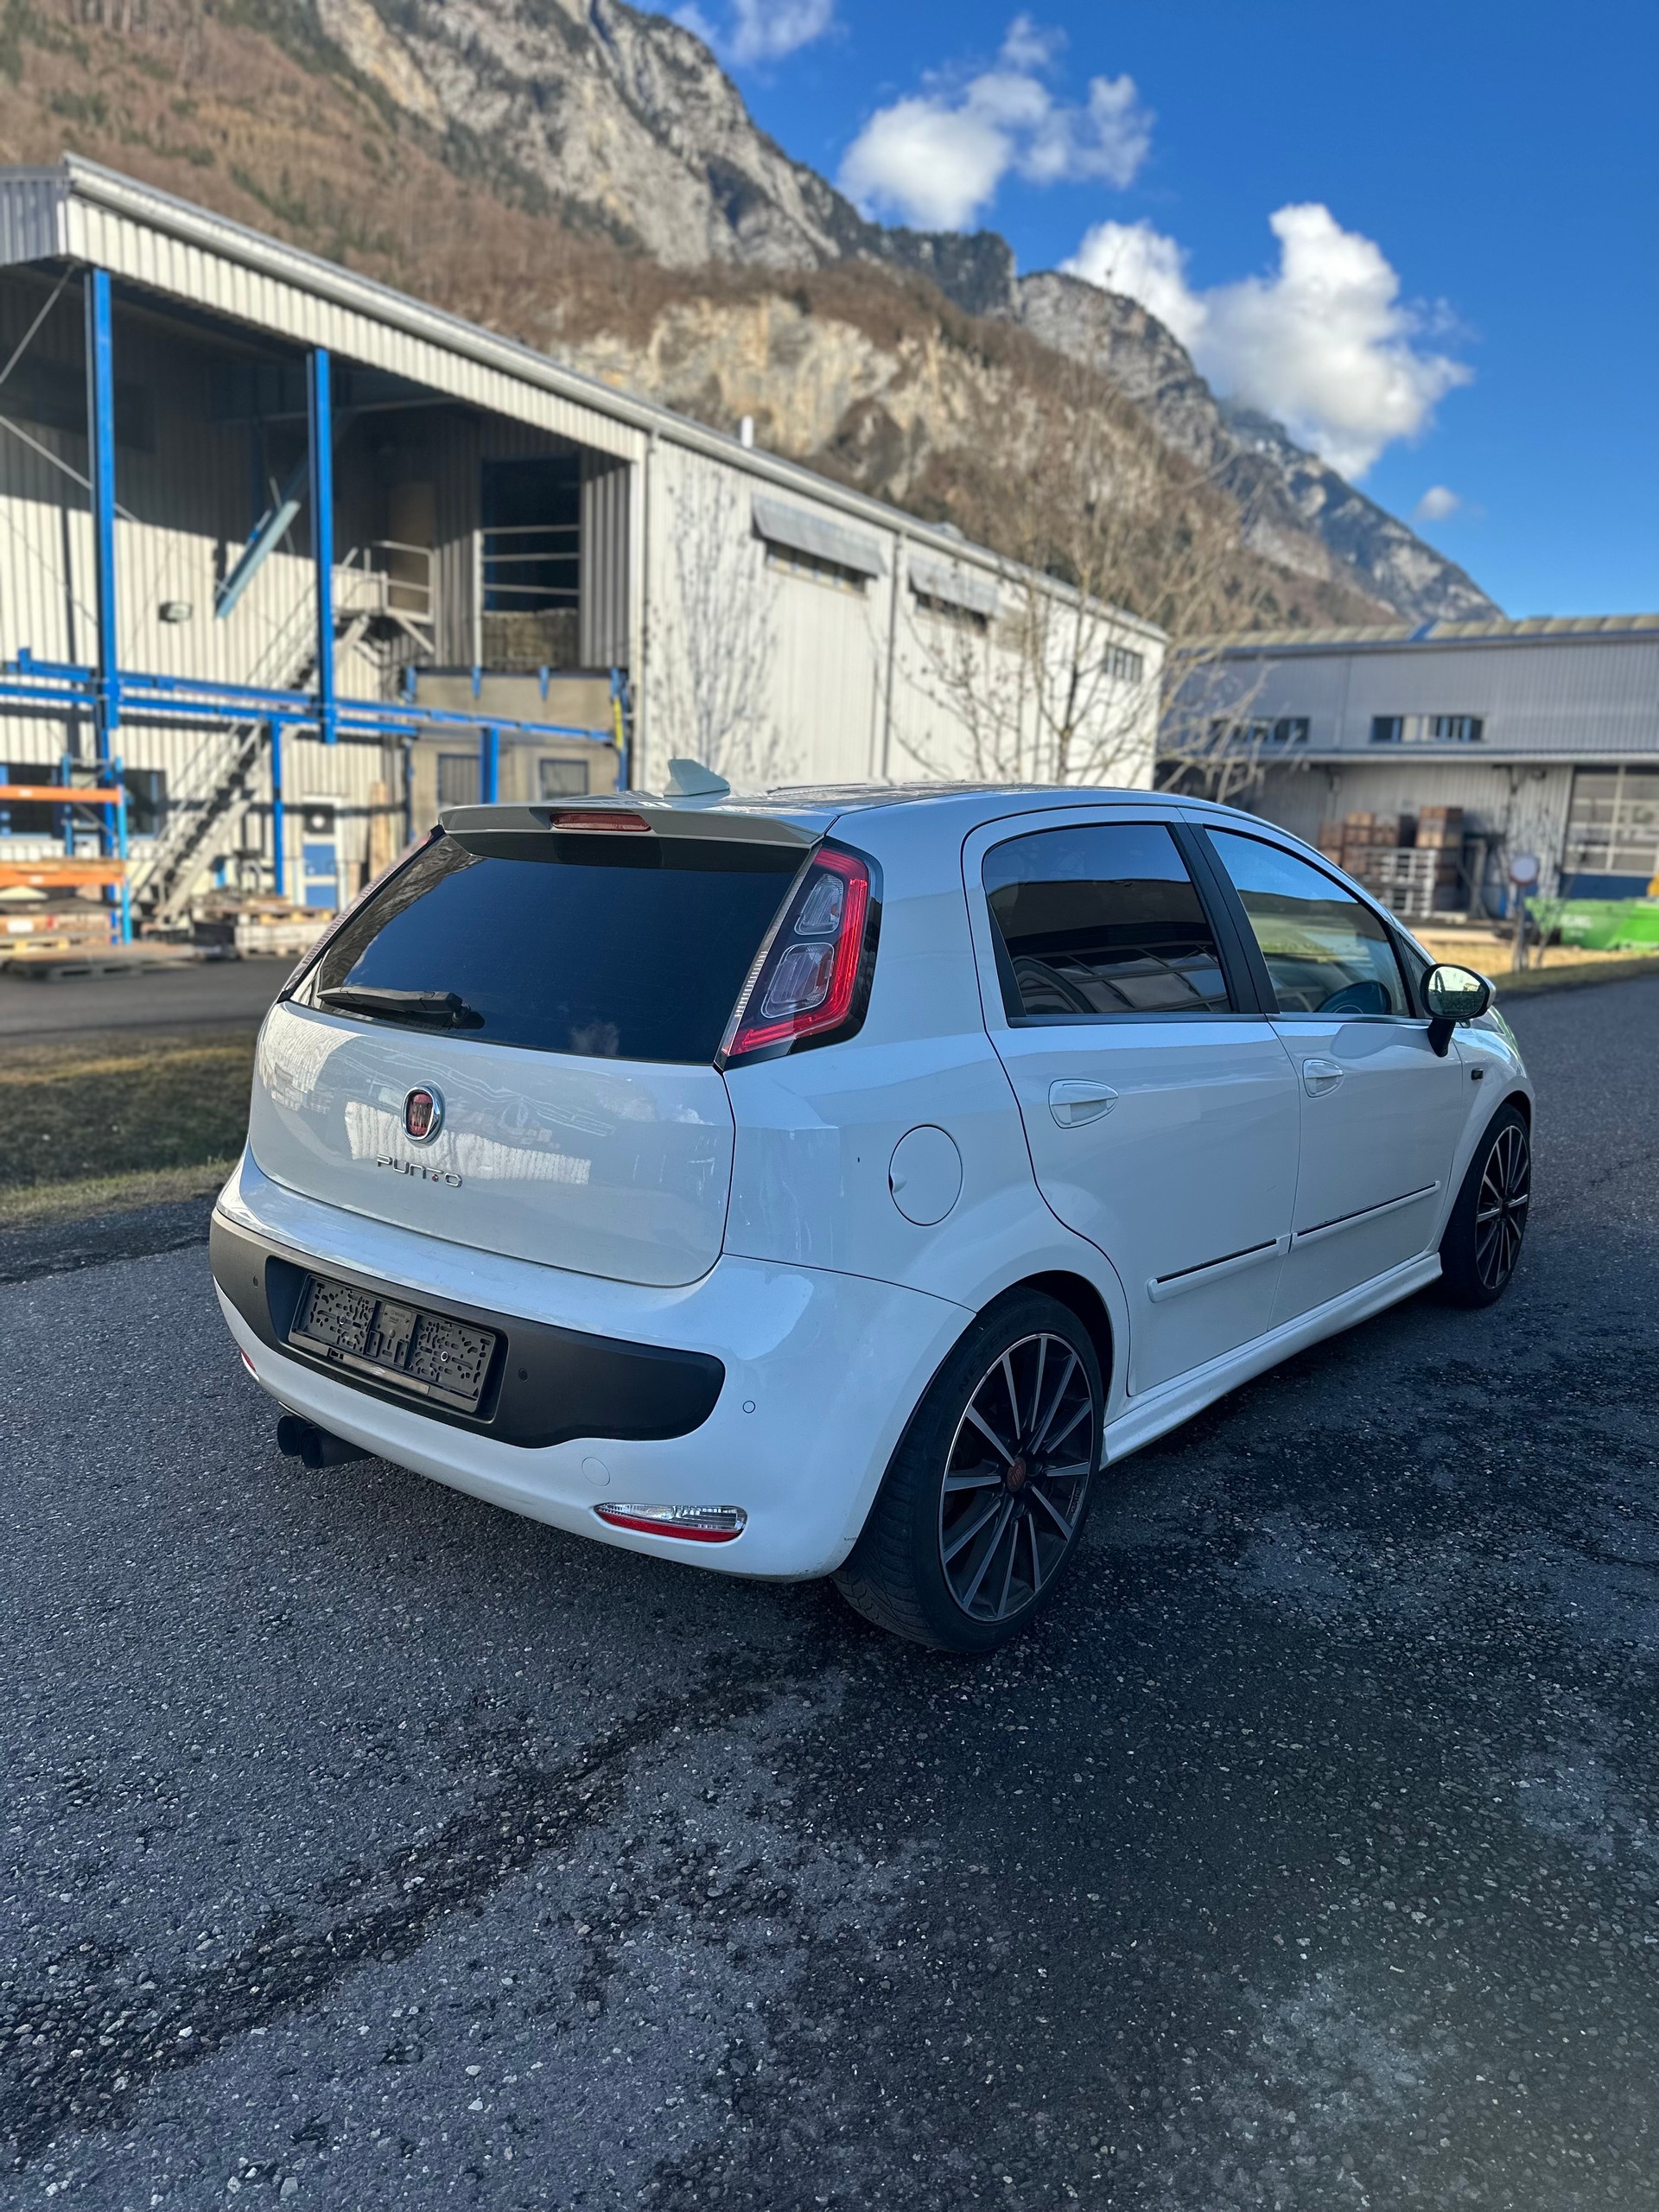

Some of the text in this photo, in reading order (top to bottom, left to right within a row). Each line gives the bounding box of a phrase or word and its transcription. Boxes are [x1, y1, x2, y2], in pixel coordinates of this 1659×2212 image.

[376, 1154, 462, 1187] PUNTO
[958, 1325, 1009, 1395] NEXEN
[1012, 1465, 1024, 1485] FIAT
